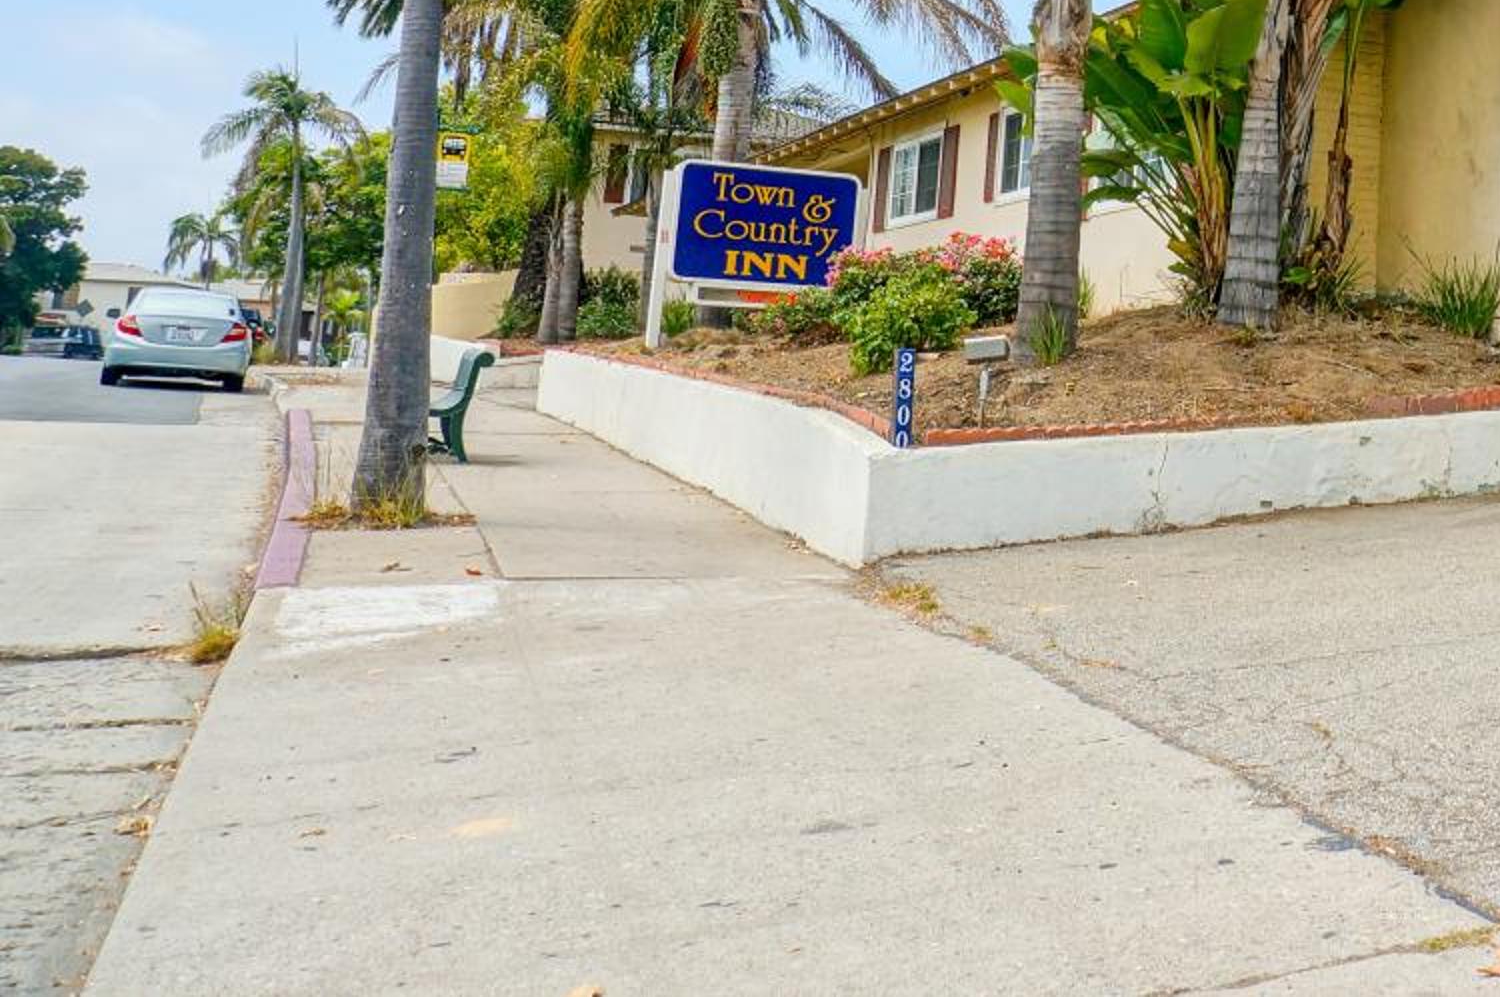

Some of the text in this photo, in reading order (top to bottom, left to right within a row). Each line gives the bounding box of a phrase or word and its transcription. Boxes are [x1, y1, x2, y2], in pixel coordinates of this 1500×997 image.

[713, 172, 836, 224] Town &
[693, 208, 839, 257] Country
[723, 250, 808, 280] INN
[896, 352, 914, 449] 2800
